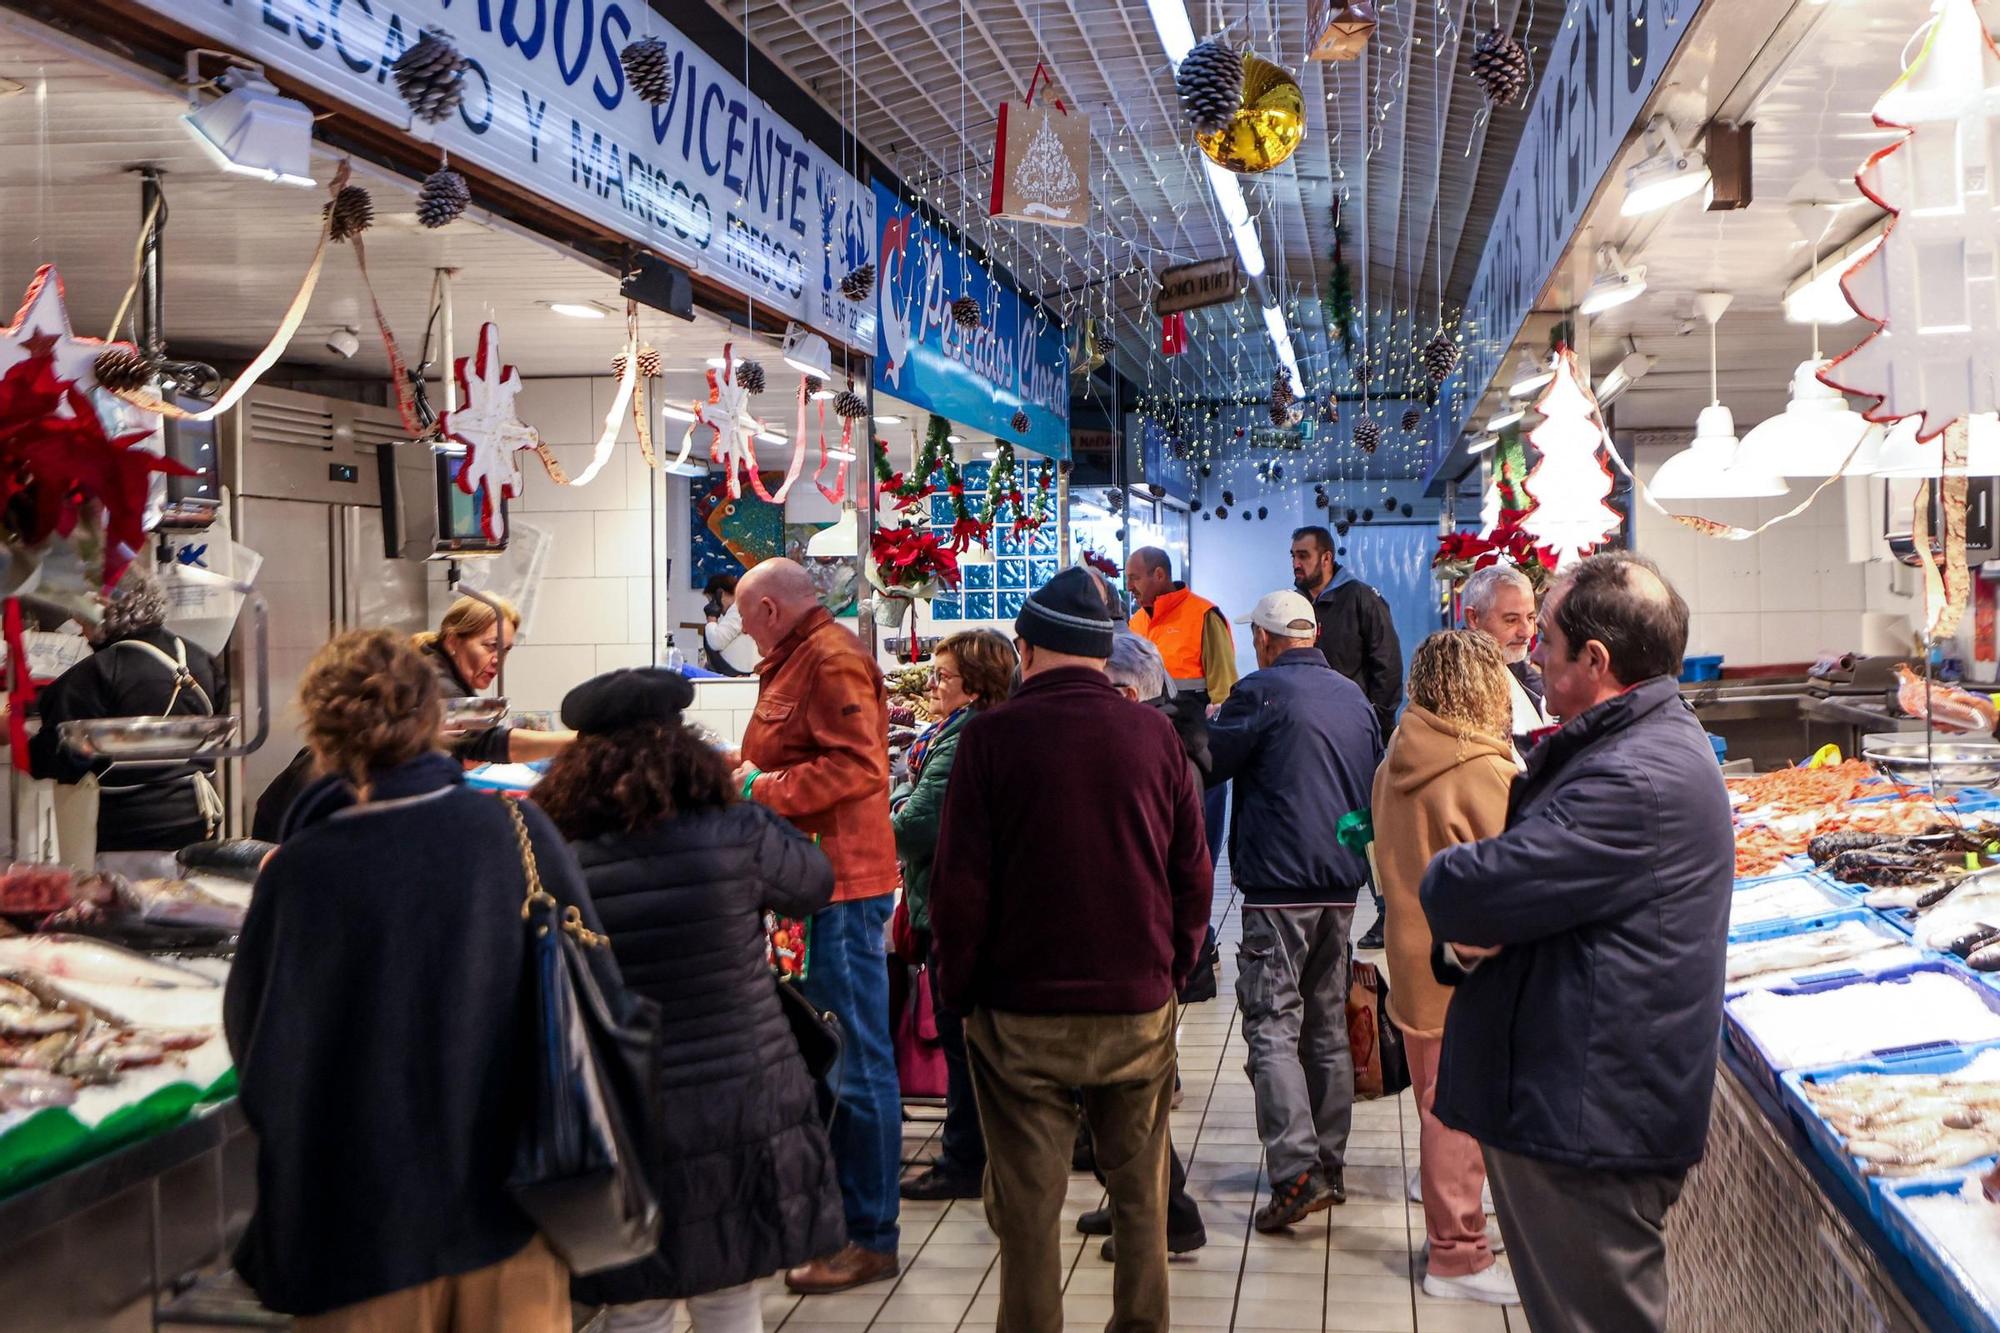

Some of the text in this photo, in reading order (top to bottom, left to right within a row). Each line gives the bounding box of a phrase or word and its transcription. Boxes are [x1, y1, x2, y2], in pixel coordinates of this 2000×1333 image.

[522, 90, 546, 163] Y
[571, 119, 712, 250] MARISCO
[726, 210, 803, 299] FRESCO
